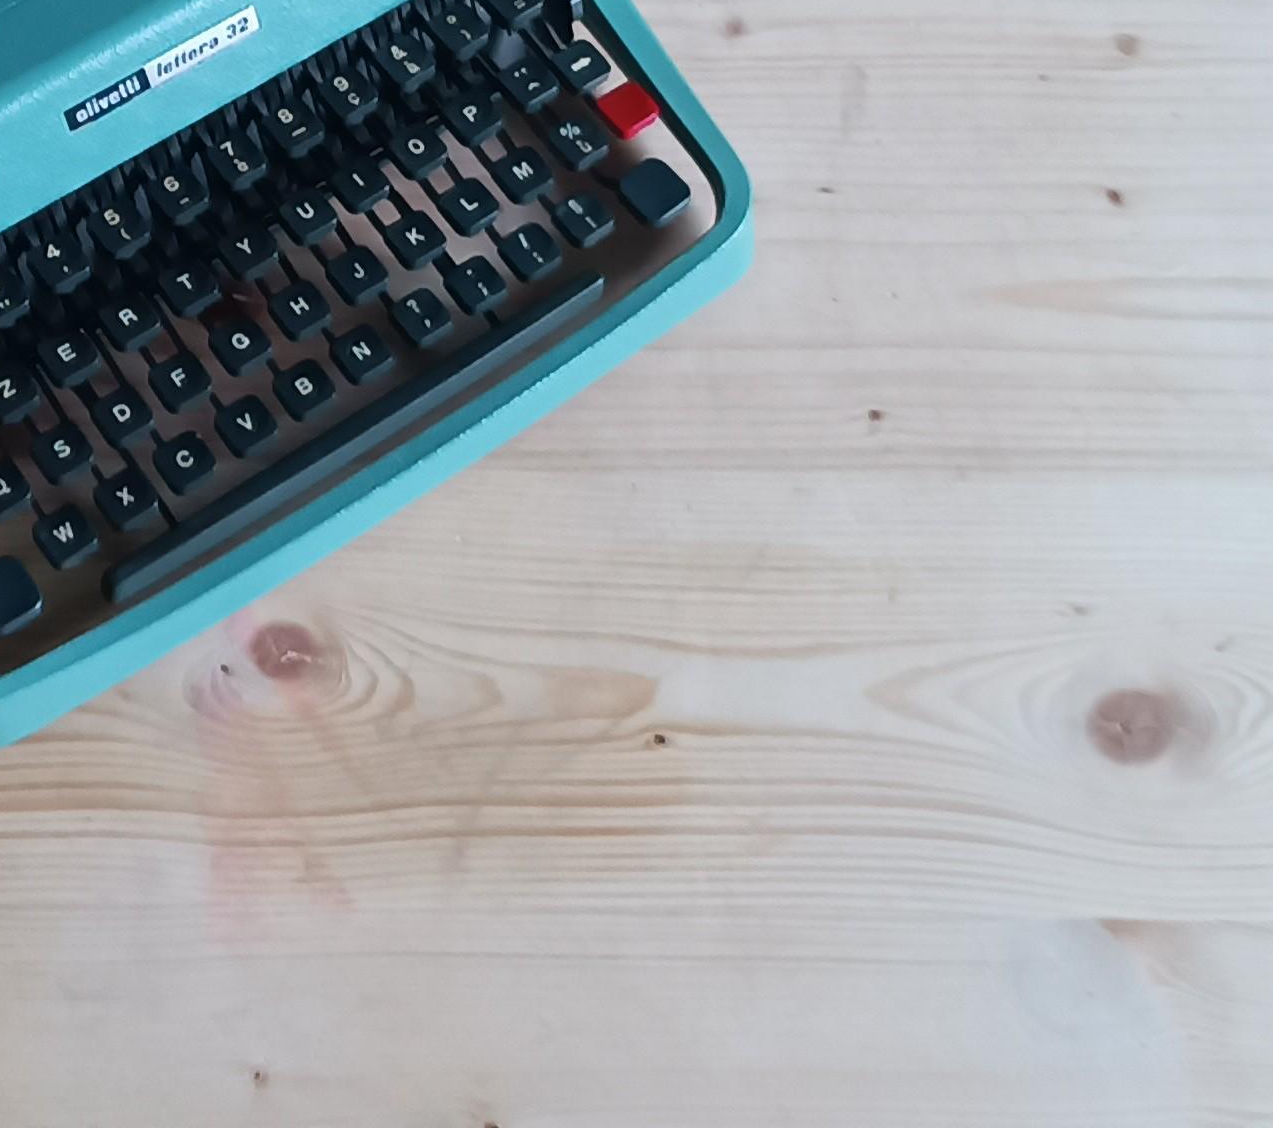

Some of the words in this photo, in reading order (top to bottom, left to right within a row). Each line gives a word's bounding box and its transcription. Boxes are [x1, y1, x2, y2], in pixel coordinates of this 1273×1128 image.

[46, 243, 61, 259] 4
[103, 208, 121, 226] 5
[163, 176, 180, 193] 6
[219, 140, 234, 157] 7
[277, 108, 294, 124] 8
[333, 76, 350, 93] 9
[75, 75, 141, 123] olivetti
[156, 36, 219, 77] lettera
[226, 16, 249, 40] 32
[53, 438, 72, 459] S
[112, 403, 132, 424] D
[169, 367, 187, 388] F
[288, 296, 310, 316] H
[353, 262, 366, 280] J
[404, 226, 426, 247] K
[458, 197, 480, 212] L
[511, 160, 535, 181] M
[559, 122, 582, 141] %
[56, 341, 78, 363] E
[117, 307, 139, 327] R
[175, 272, 193, 291] T
[235, 237, 253, 255] Y
[295, 201, 316, 220] U
[351, 172, 366, 188] I
[407, 137, 426, 155] O
[461, 104, 478, 123] P
[52, 520, 74, 543] W
[115, 486, 136, 507] X
[175, 449, 195, 469] C
[235, 412, 254, 431] V
[293, 376, 314, 397] B
[350, 340, 373, 361] N
[405, 298, 421, 314] ?
